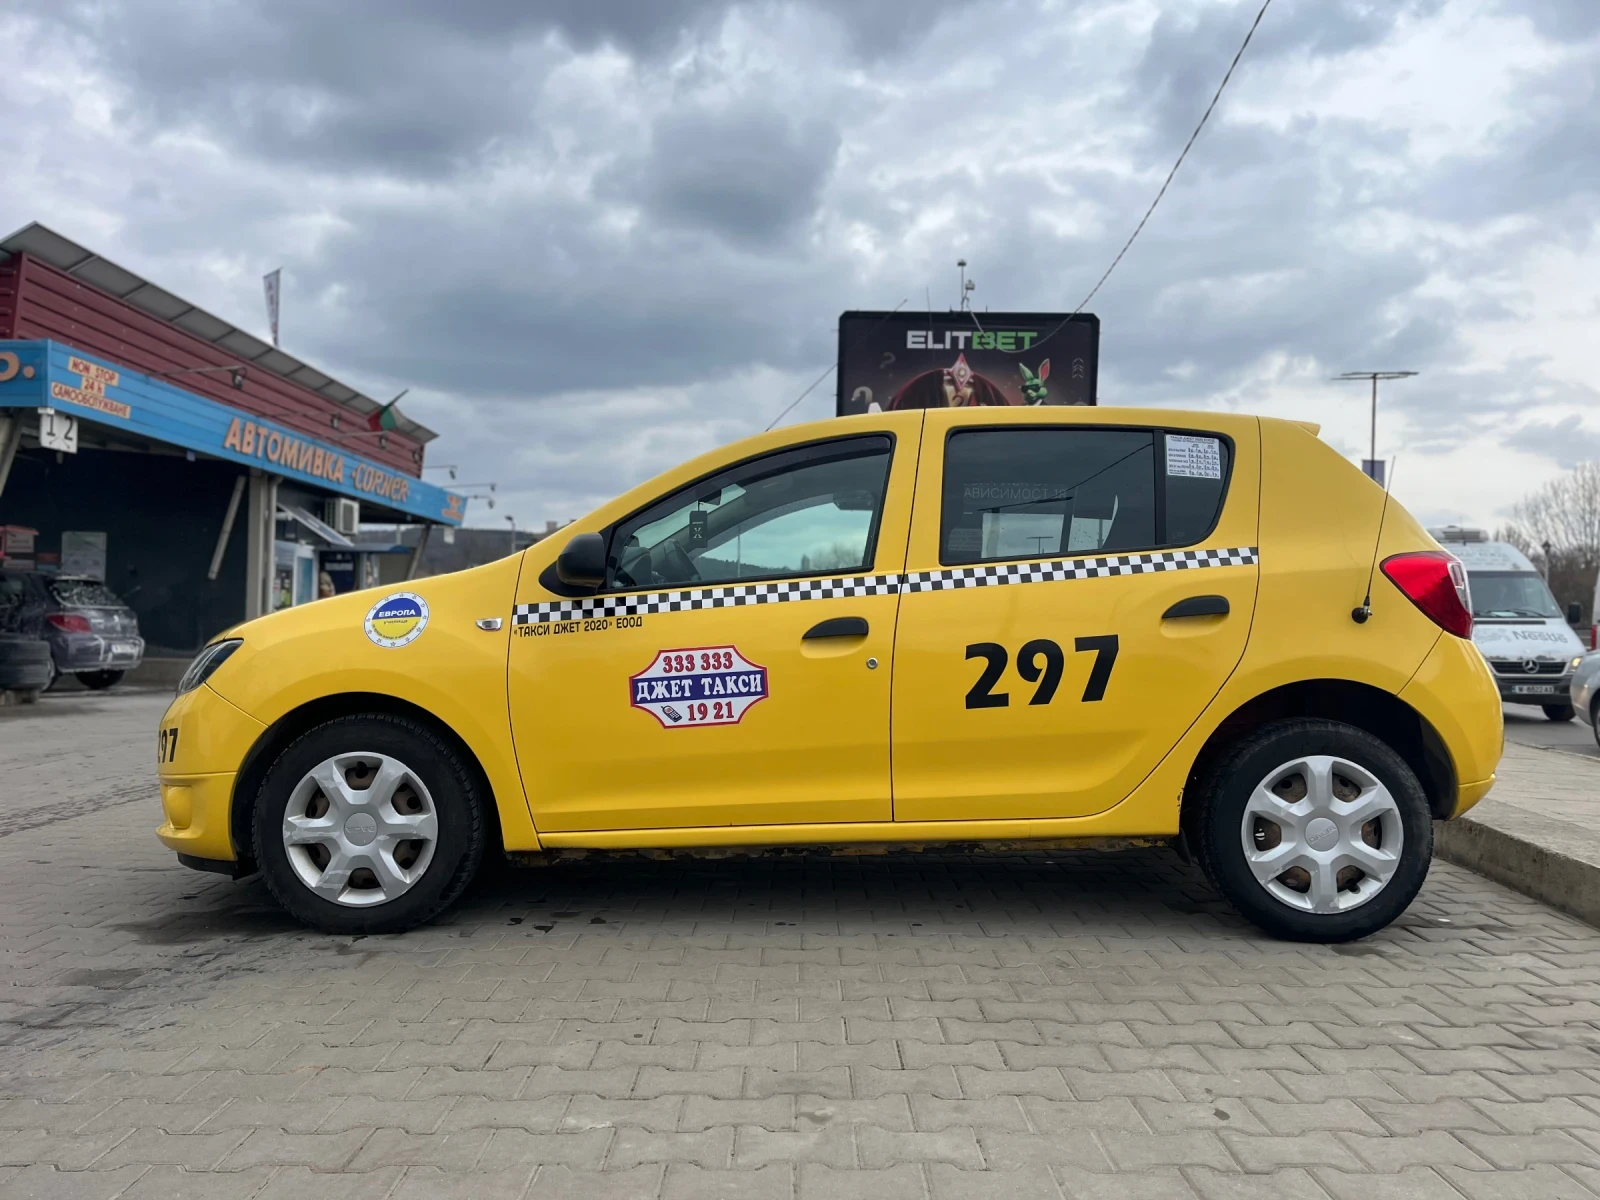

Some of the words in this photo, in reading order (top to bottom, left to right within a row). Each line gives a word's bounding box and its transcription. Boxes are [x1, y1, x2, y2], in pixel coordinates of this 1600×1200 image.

[906, 330, 1037, 350] ELITBET
[71, 358, 91, 374] NON
[95, 367, 116, 383] STOP
[84, 379, 95, 391] 24
[64, 415, 73, 441] 2
[224, 416, 344, 484] АВТОМИВКА
[378, 609, 416, 618] ЕВРОПА
[553, 621, 581, 634] ДЖЕТ
[616, 616, 643, 628] ЕООД
[662, 654, 696, 673] 333
[700, 651, 733, 671] 333
[965, 634, 1119, 709] 297
[636, 679, 692, 701] ДЖЕТ
[700, 674, 762, 695] ТАКСИ
[687, 702, 708, 721] 19
[712, 700, 735, 719] 21
